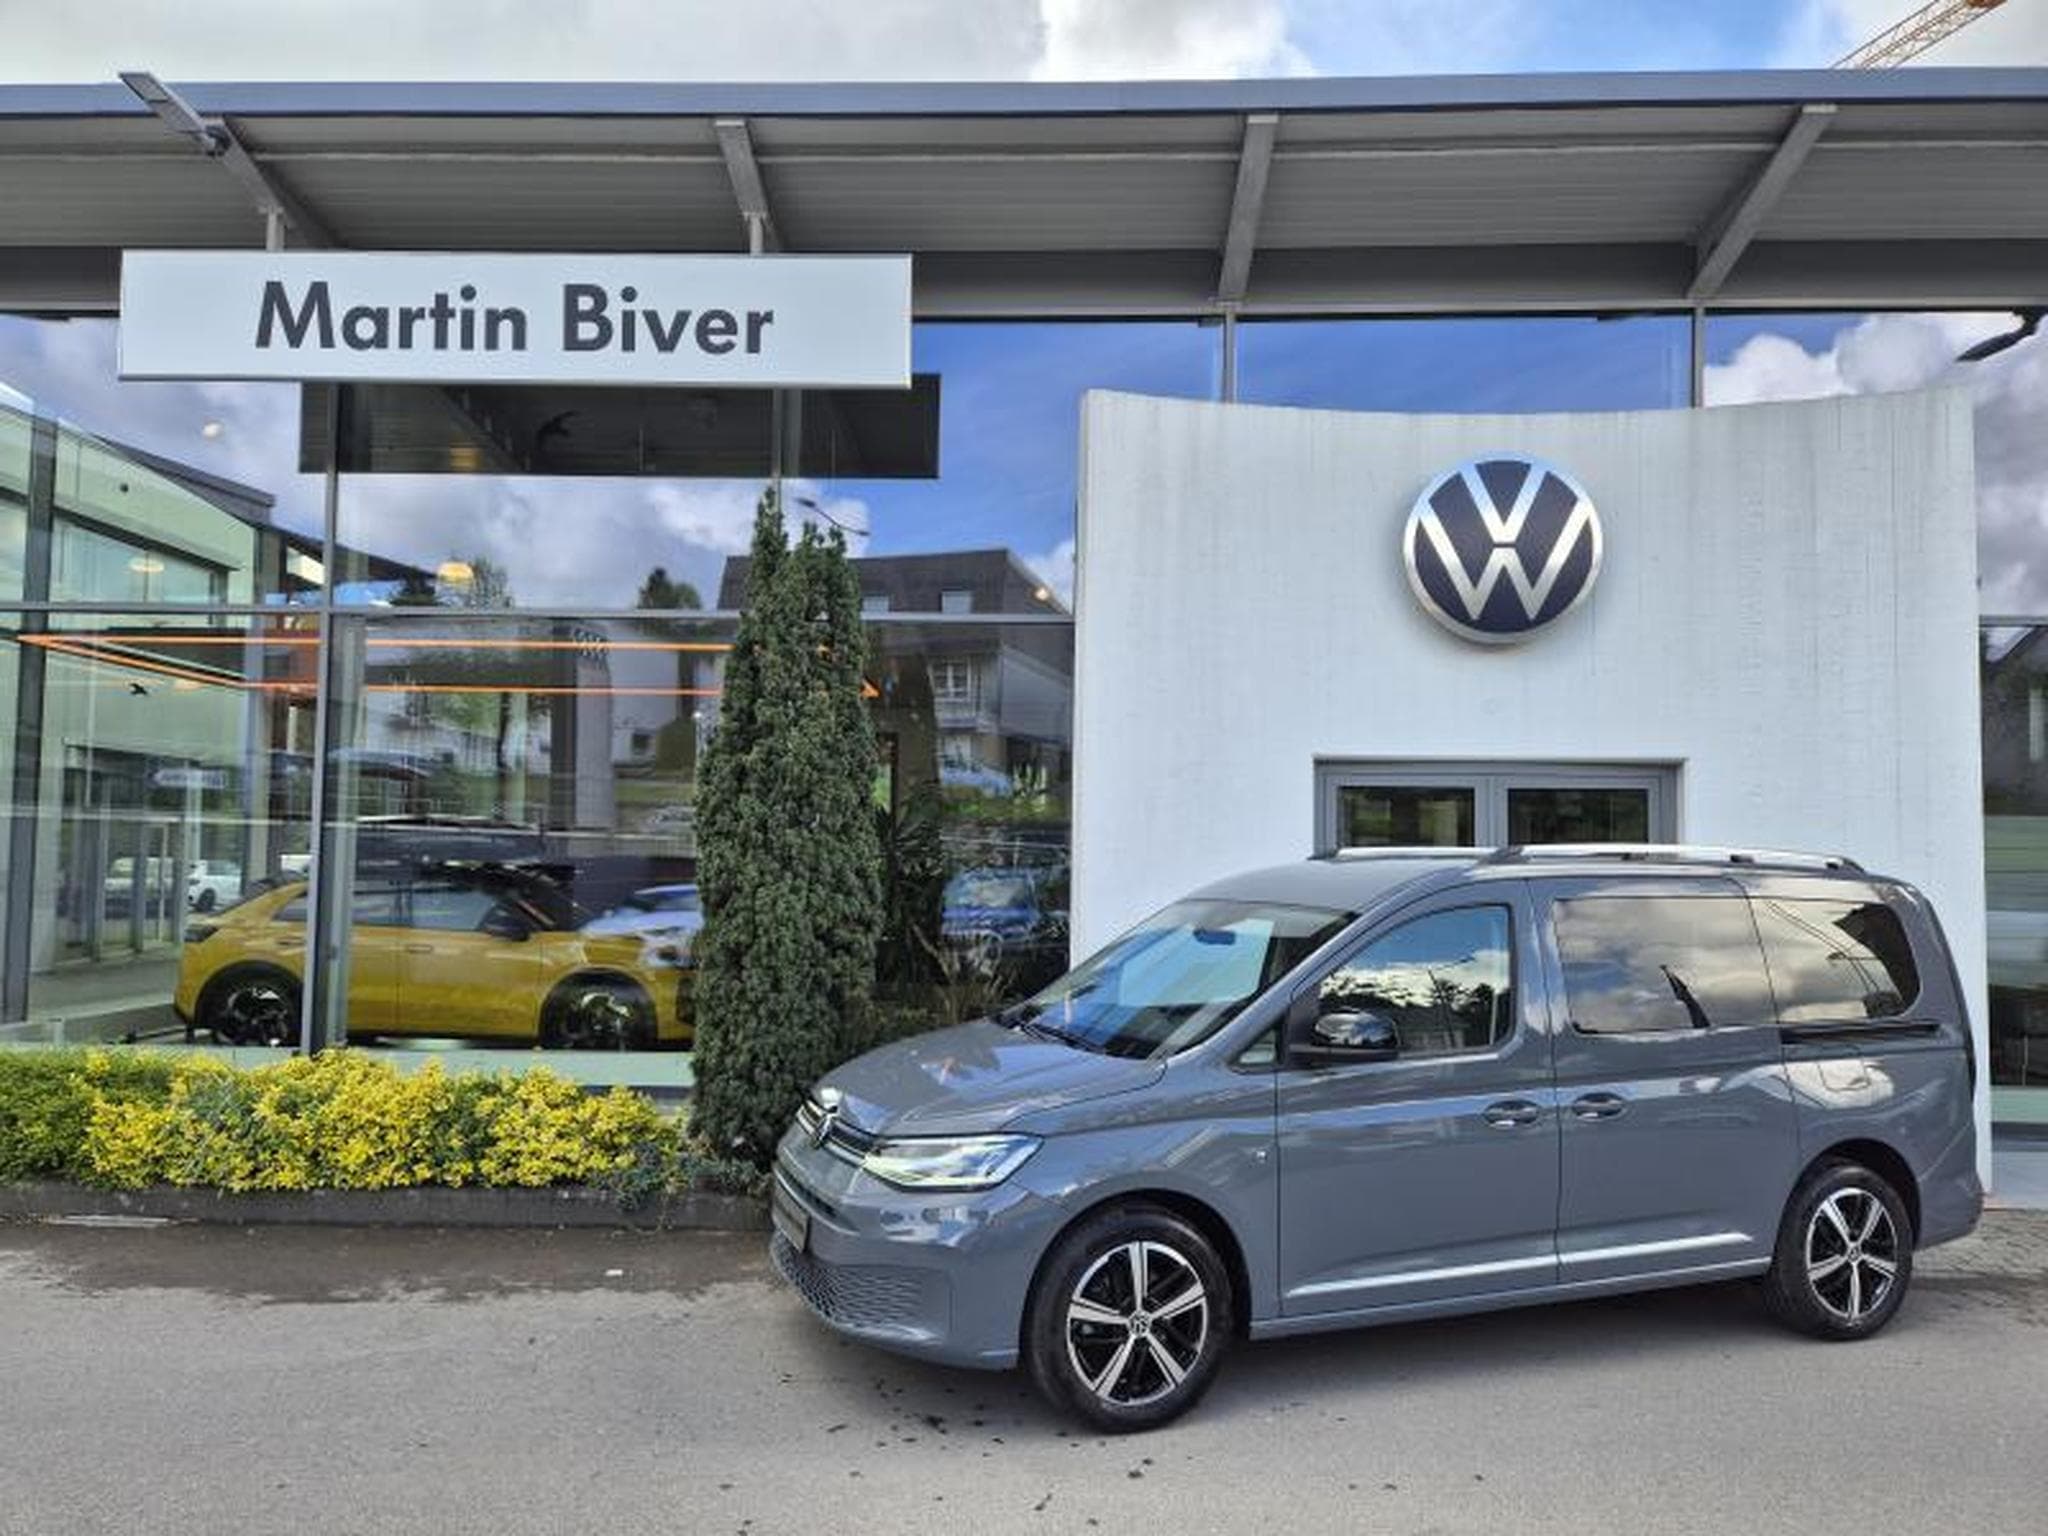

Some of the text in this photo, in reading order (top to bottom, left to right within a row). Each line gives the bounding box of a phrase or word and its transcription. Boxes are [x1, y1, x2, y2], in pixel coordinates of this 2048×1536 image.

[255, 280, 774, 354] Martin Biver
[1409, 457, 1597, 630] VW
